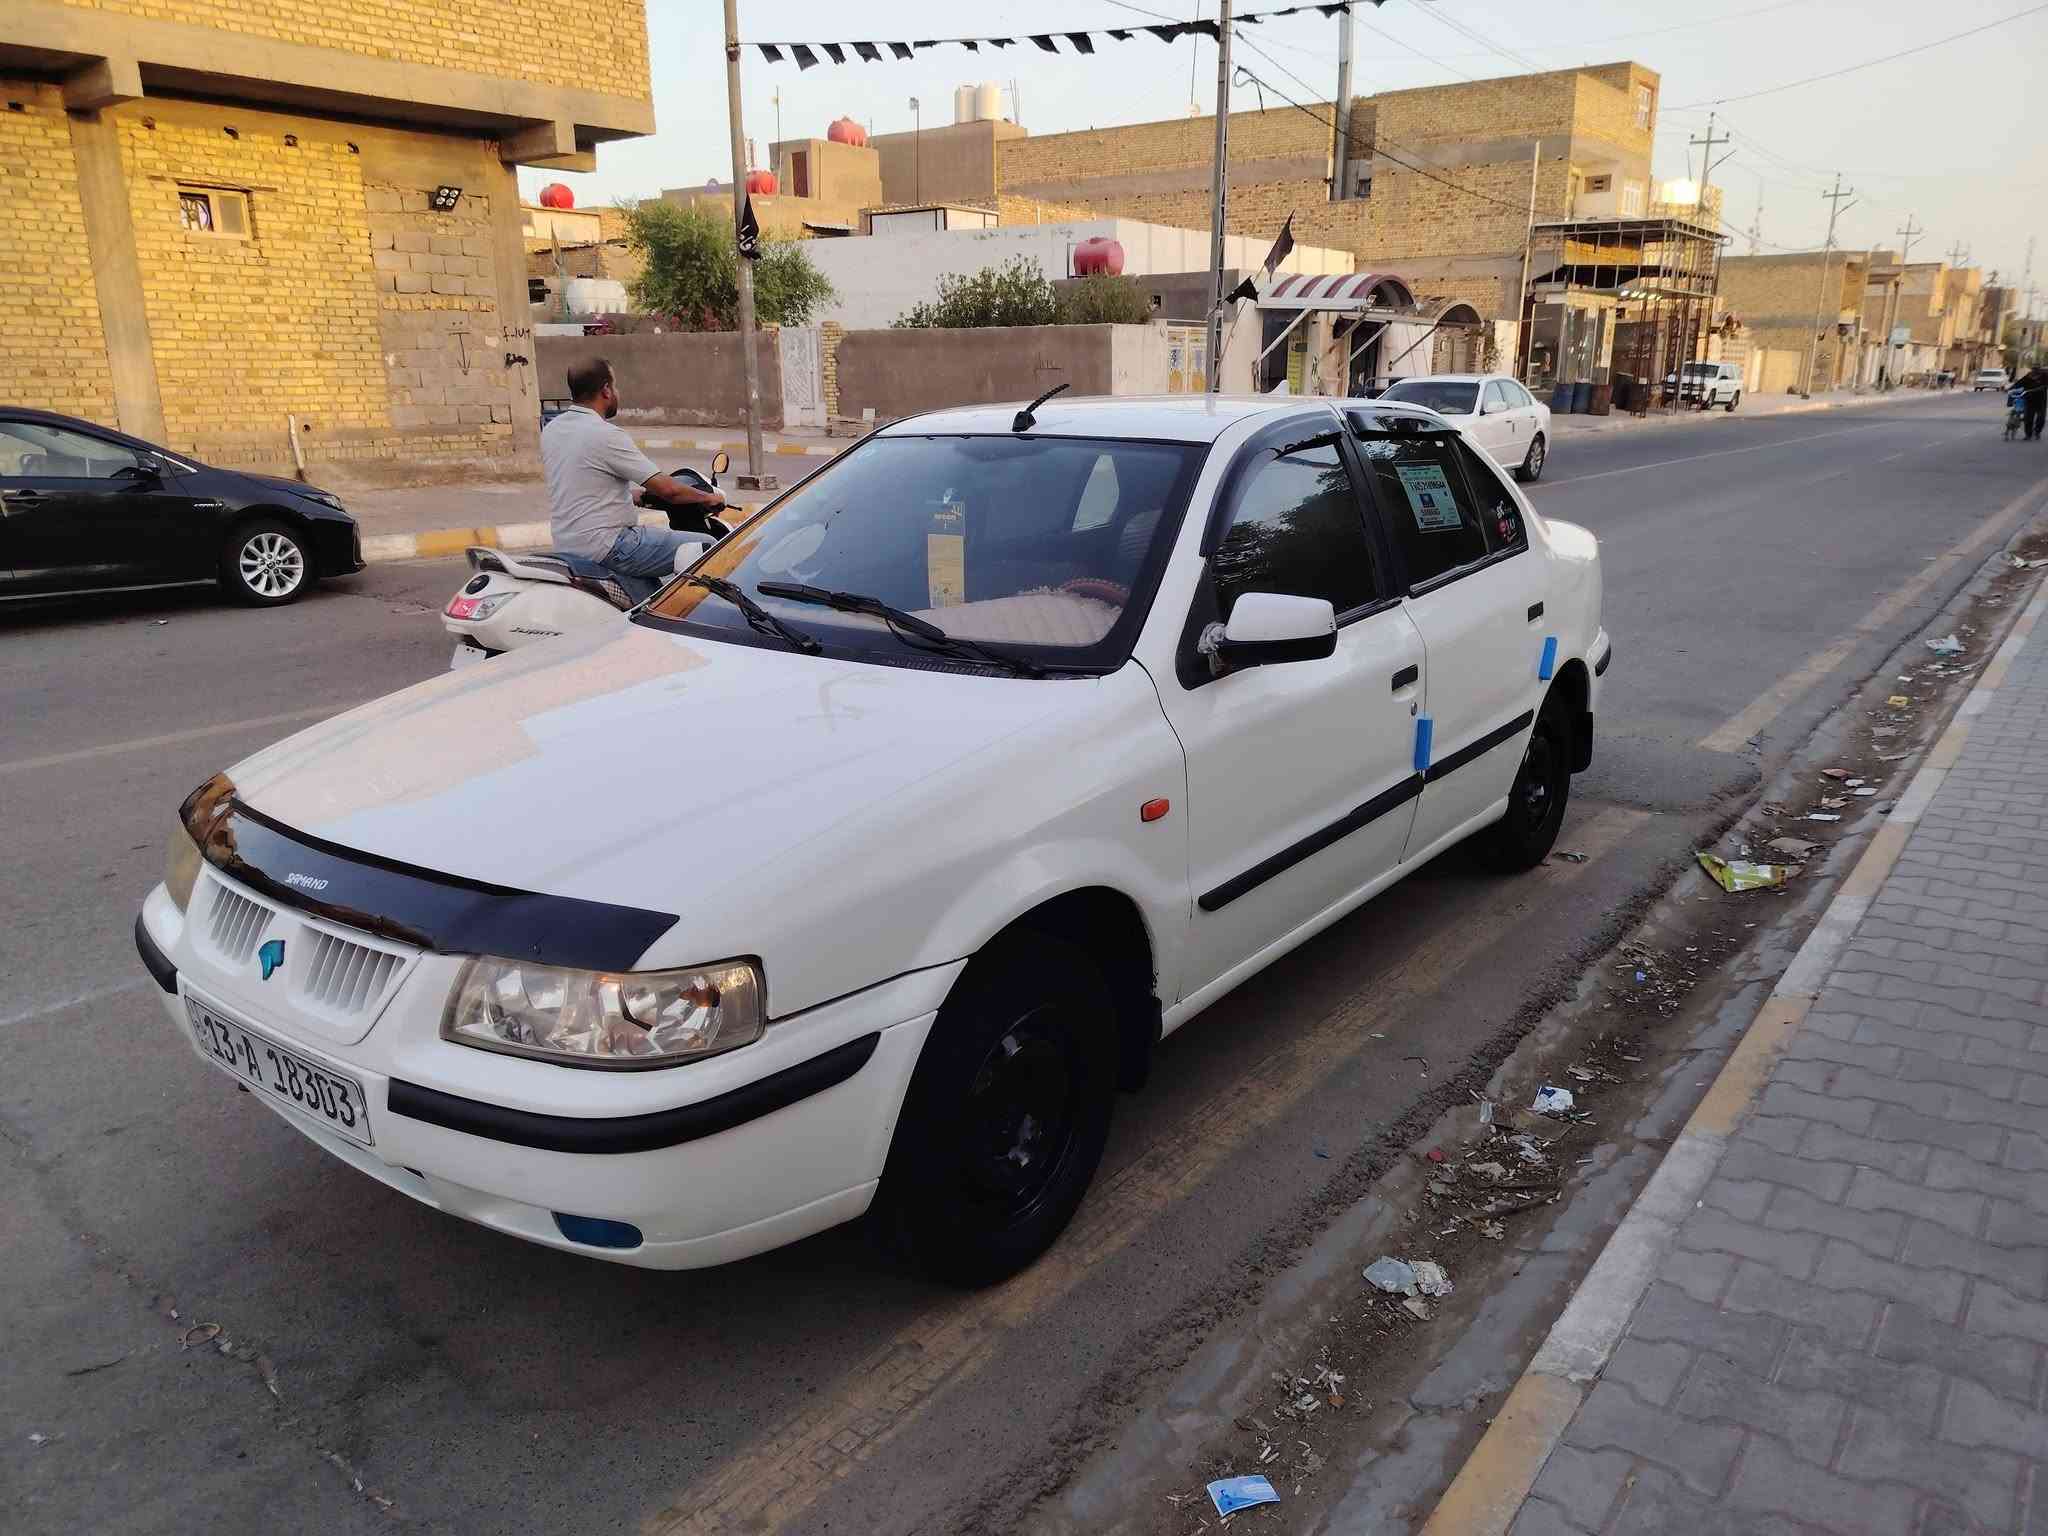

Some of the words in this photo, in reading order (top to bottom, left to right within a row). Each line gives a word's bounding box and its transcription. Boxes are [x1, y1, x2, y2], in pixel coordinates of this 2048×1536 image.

[285, 872, 329, 890] SAMAND
[203, 1014, 237, 1066] 13
[241, 1034, 263, 1082] A
[266, 1047, 356, 1128] 18303
